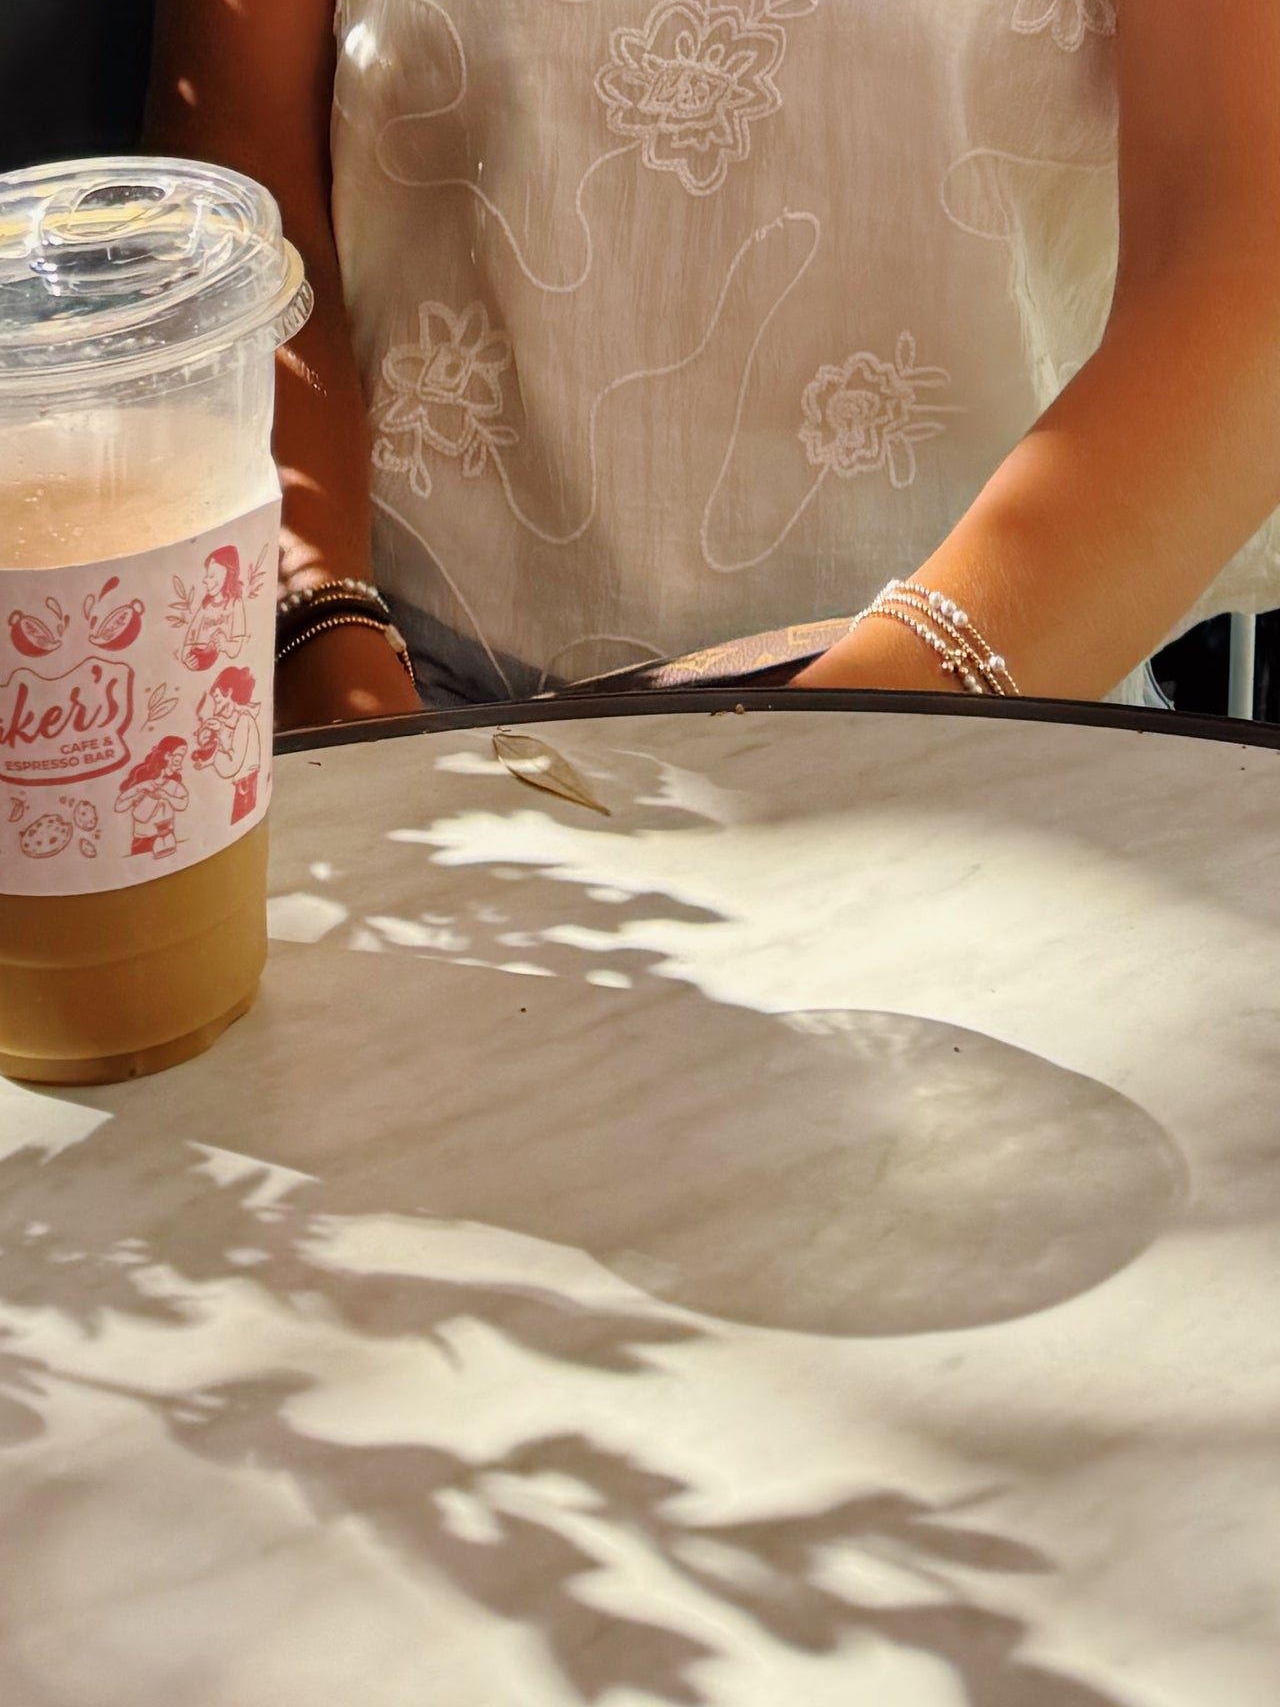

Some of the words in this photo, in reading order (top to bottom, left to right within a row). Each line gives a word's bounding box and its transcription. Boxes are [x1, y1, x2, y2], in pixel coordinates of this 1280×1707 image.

[60, 738, 99, 755] CAFE
[102, 736, 114, 747] &
[4, 755, 80, 771] ESPRESSO
[83, 749, 115, 764] BAR
